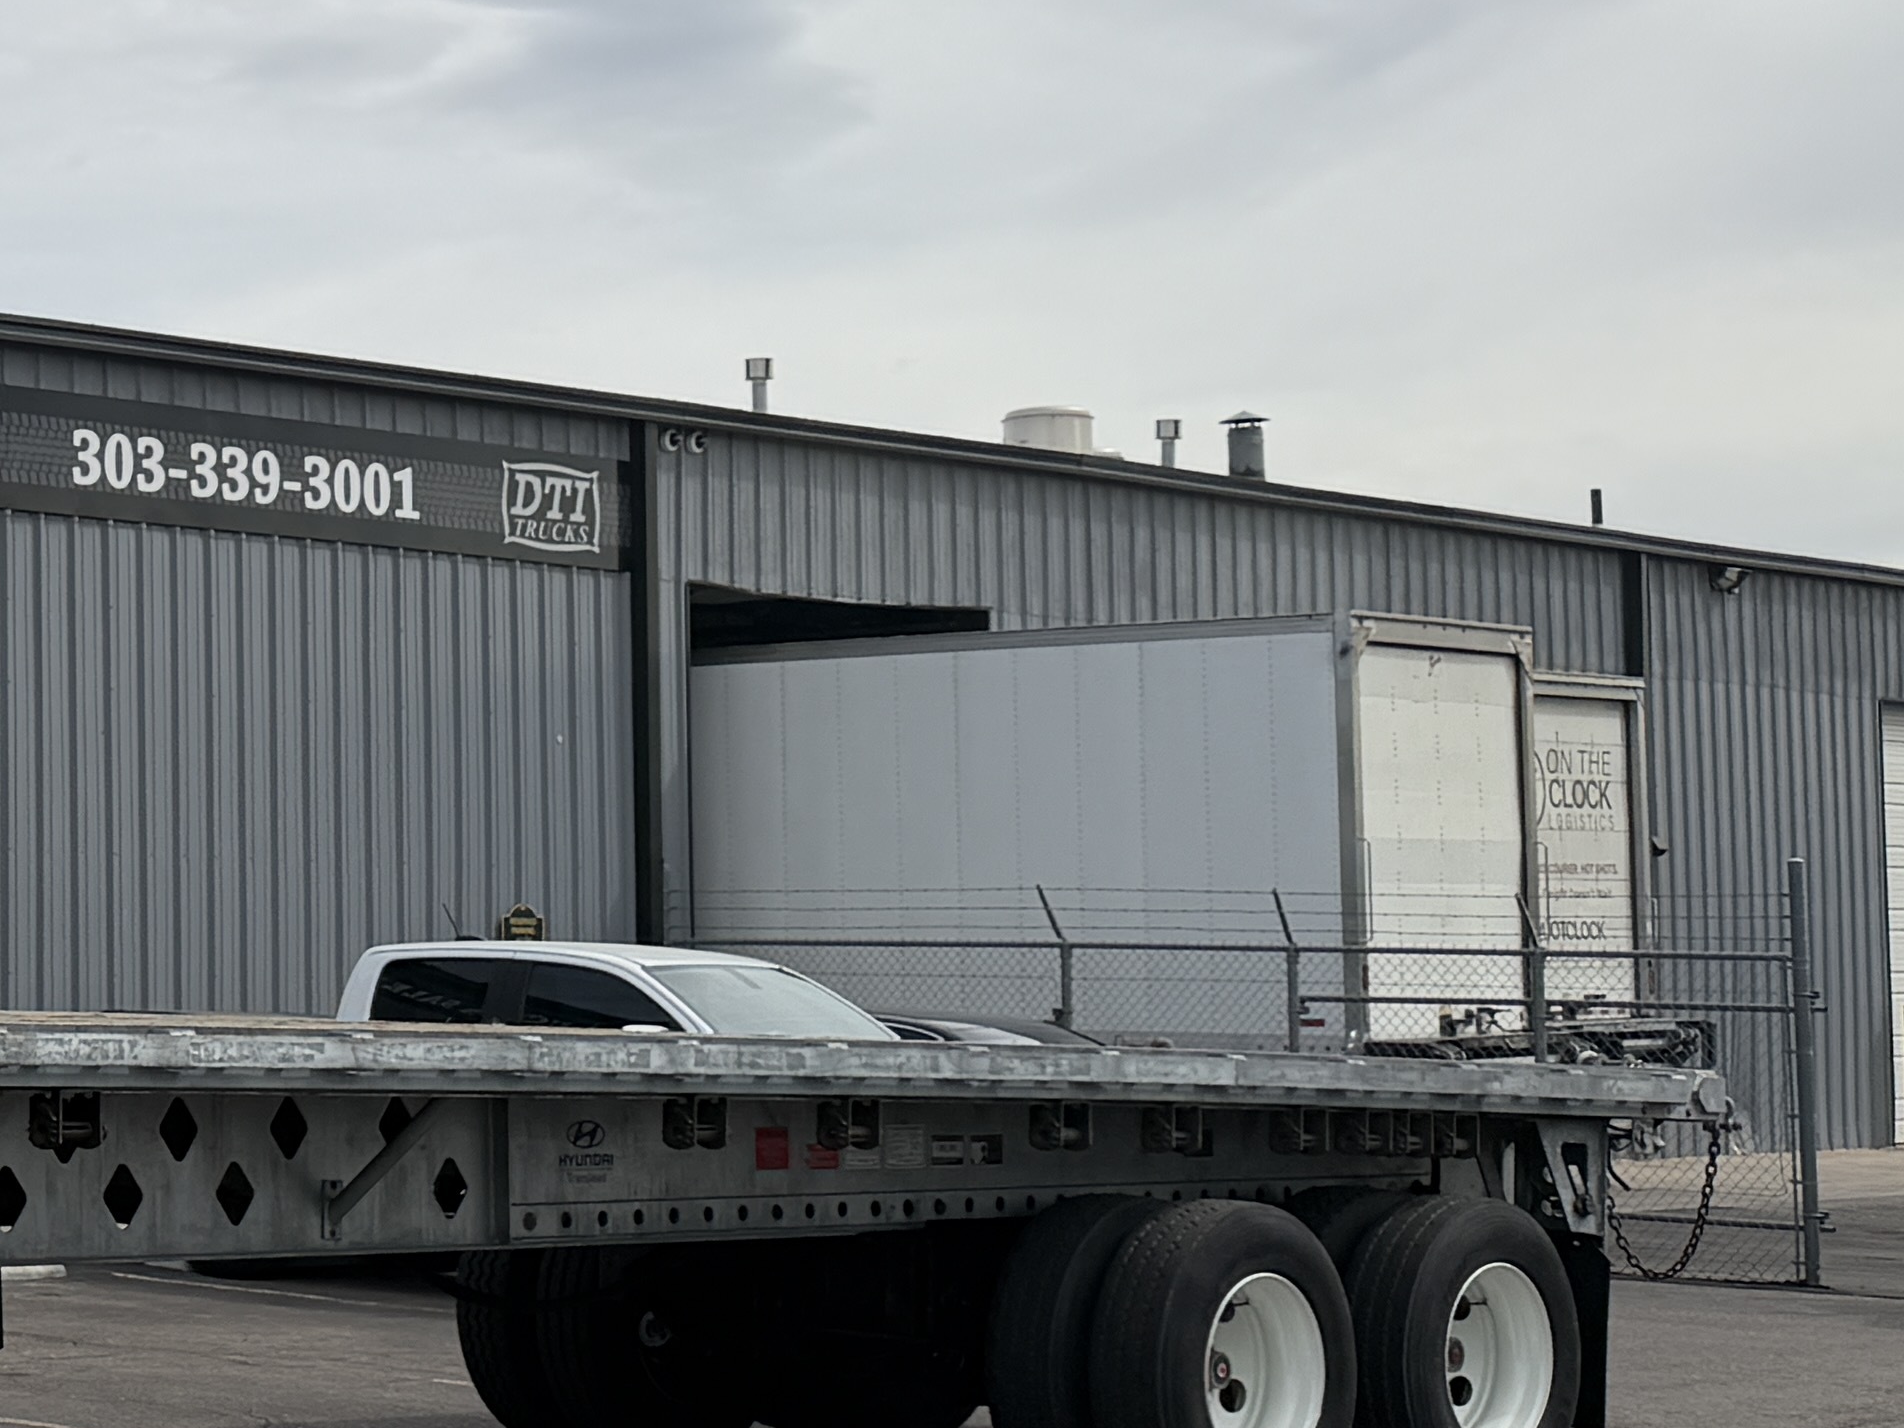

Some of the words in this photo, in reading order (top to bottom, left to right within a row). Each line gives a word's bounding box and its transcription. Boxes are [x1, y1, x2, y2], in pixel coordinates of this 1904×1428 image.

[72, 428, 420, 520] 303-339-3001
[510, 472, 590, 523] DTI
[514, 518, 590, 543] TRUCKS
[1546, 748, 1572, 775] ON
[1577, 750, 1612, 776] THE
[1549, 778, 1612, 809] CLOCK
[1548, 813, 1615, 831] LOGISTICS
[559, 1154, 614, 1167] HYUNDAI
